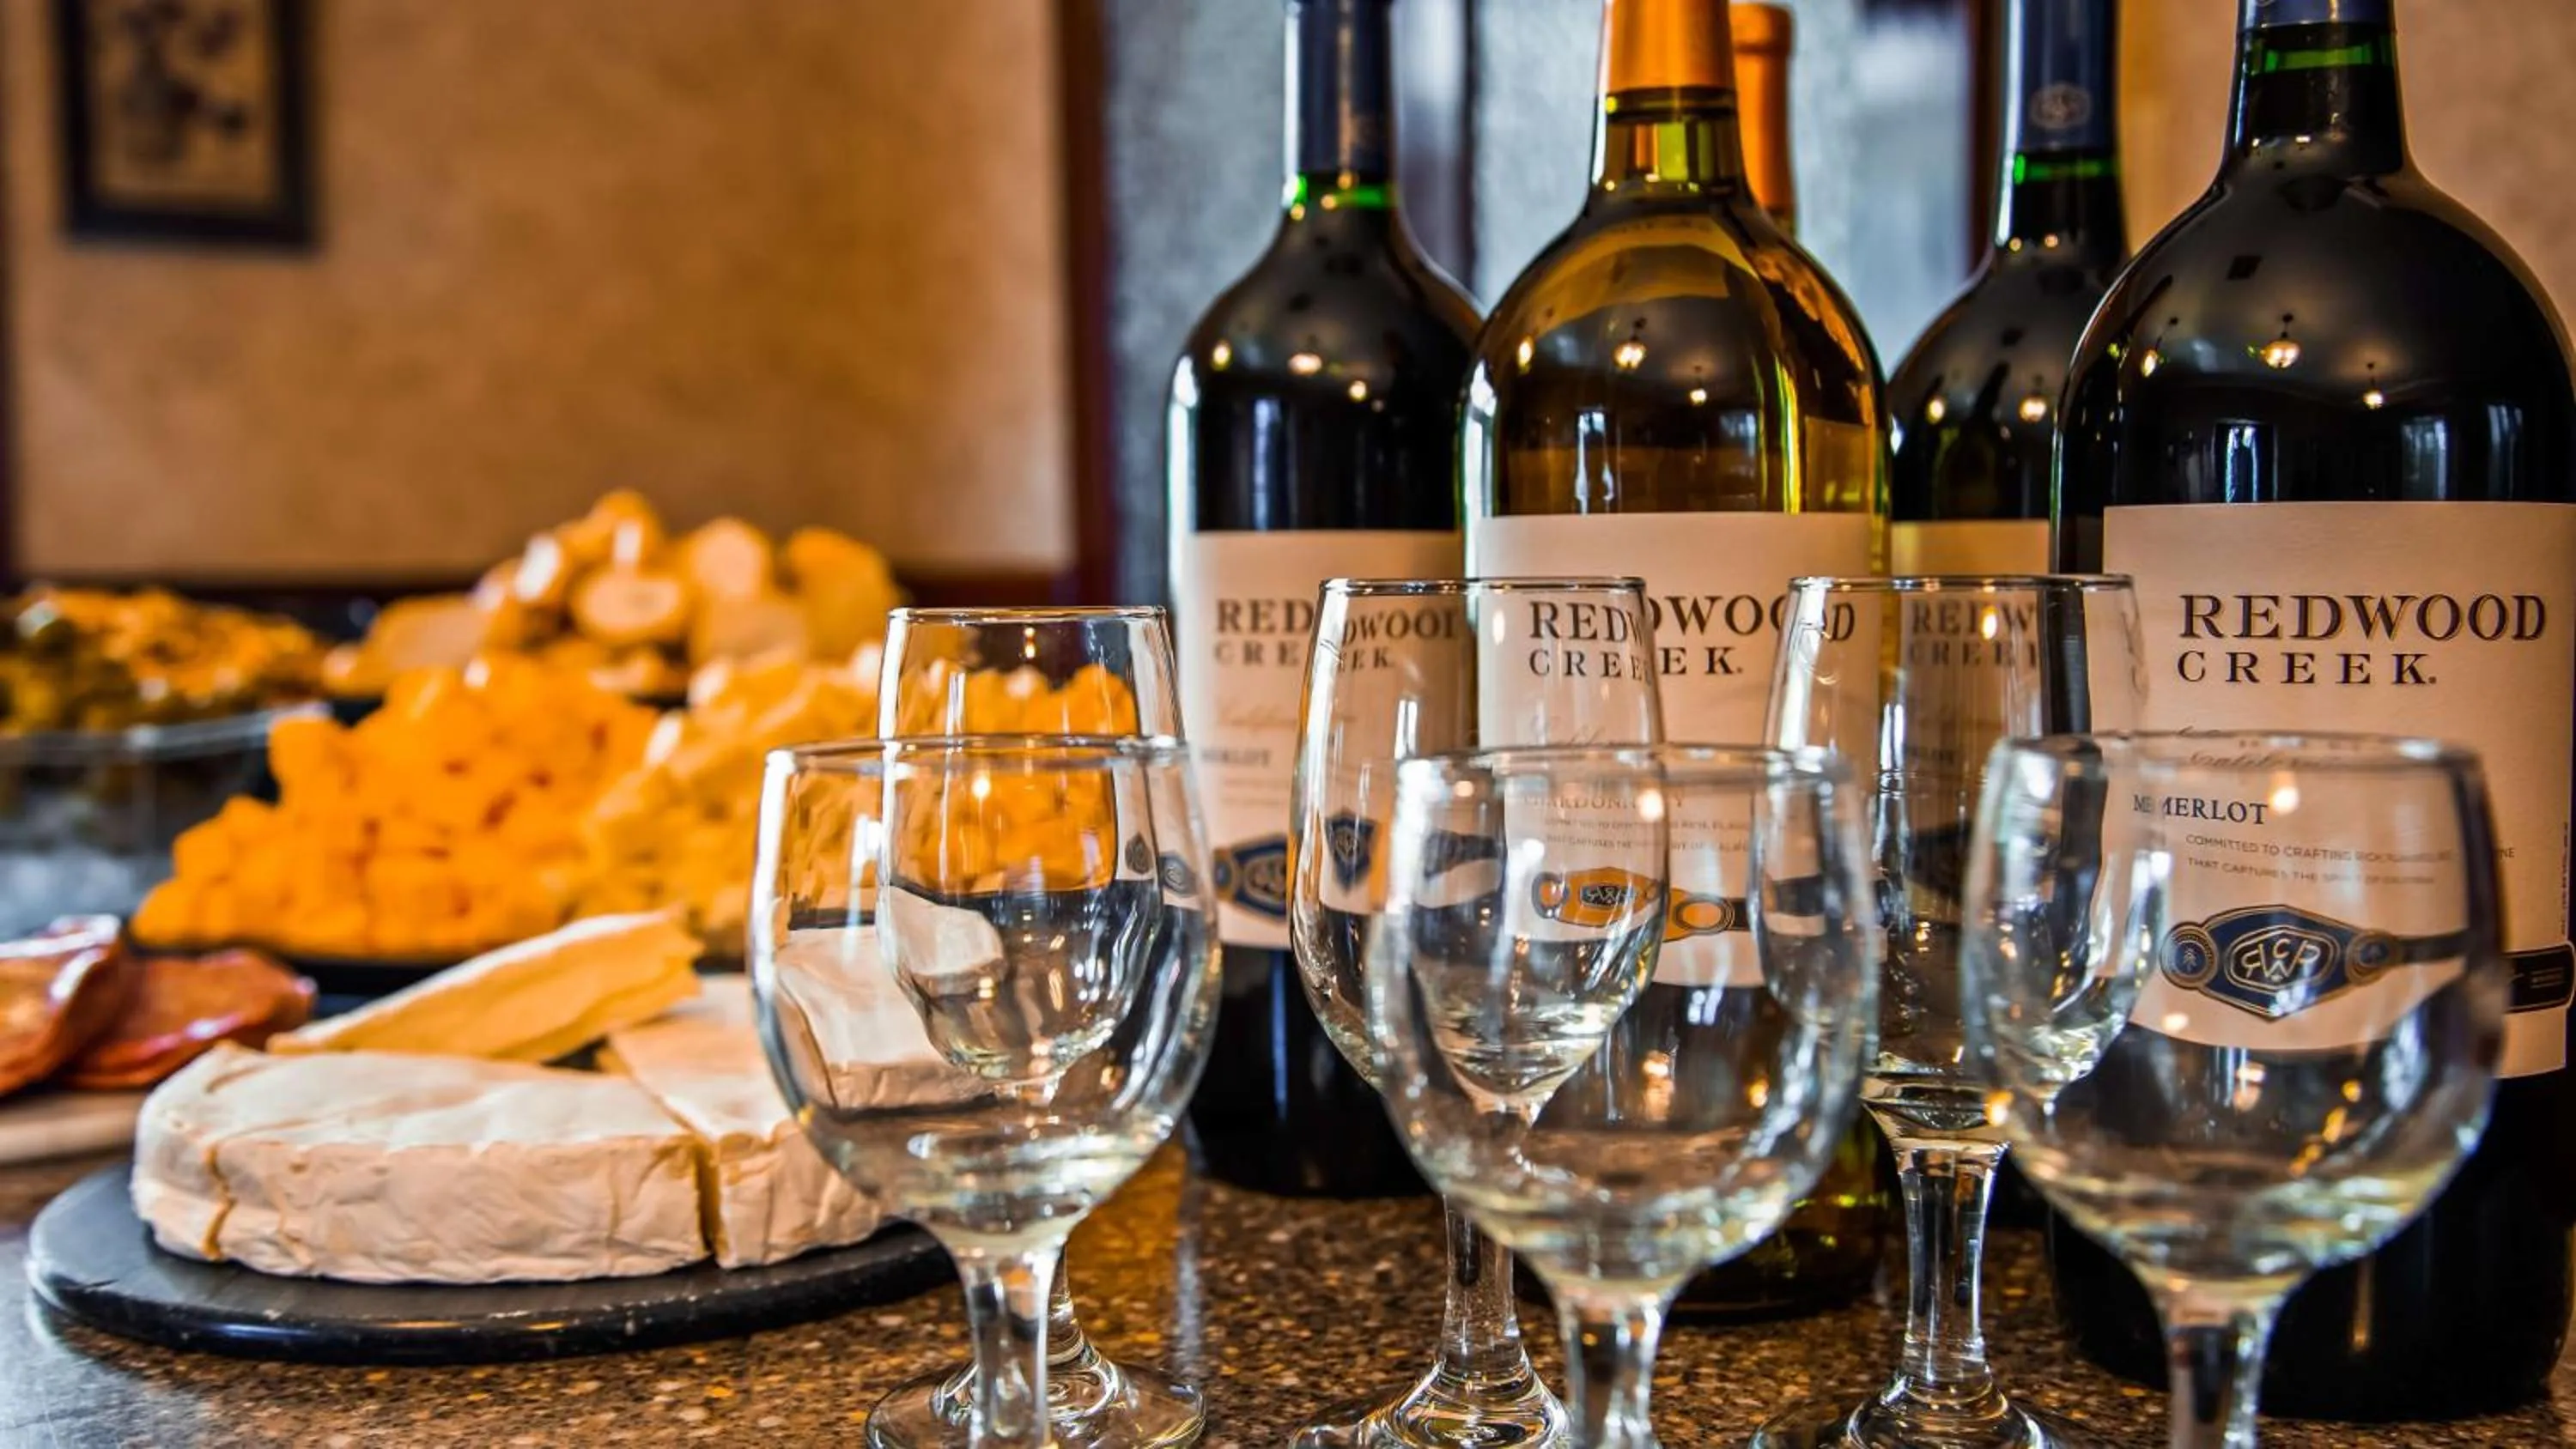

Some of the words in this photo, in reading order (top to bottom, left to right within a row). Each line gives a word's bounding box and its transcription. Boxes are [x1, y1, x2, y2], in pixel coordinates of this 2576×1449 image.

[2178, 594, 2547, 641] REDWOOD
[2185, 834, 2258, 853] COMMITTED
[2262, 843, 2281, 857] TO
